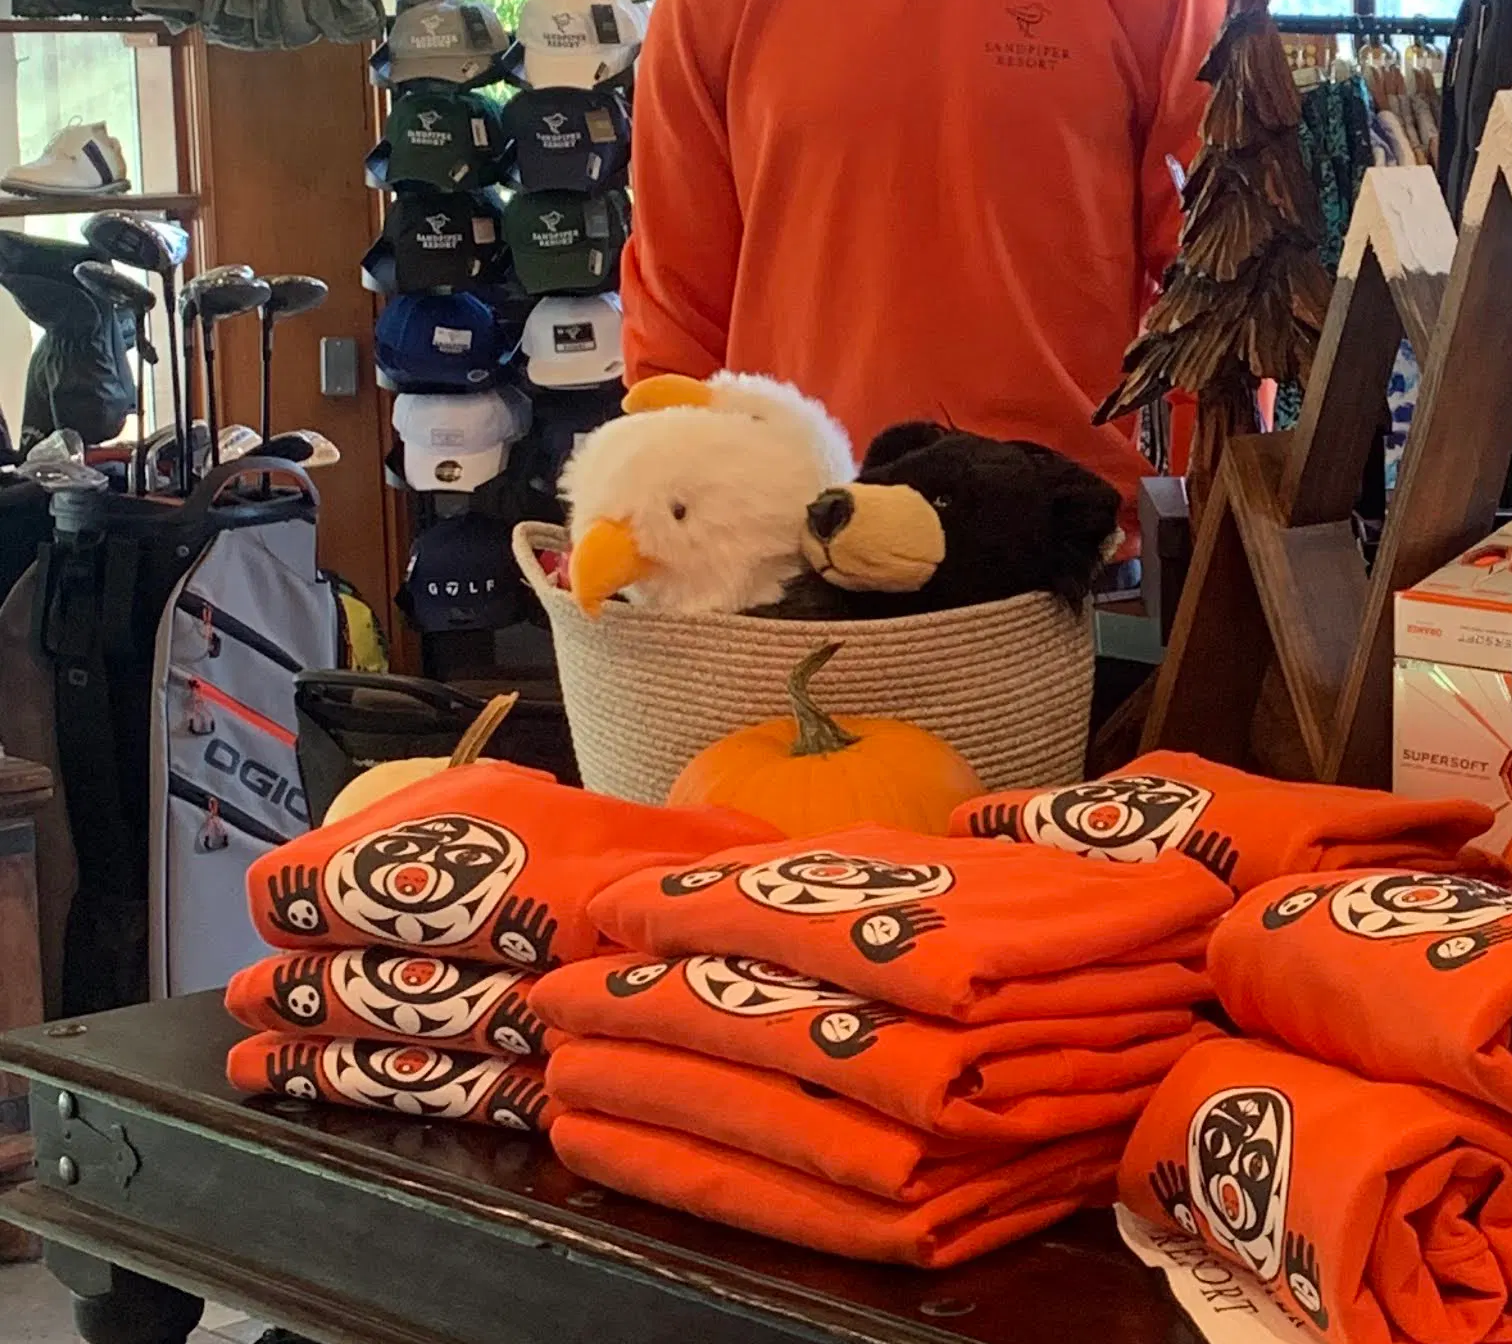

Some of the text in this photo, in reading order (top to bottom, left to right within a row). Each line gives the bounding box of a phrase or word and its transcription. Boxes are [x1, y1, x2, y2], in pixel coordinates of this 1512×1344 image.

[984, 41, 1071, 60] SANDPIPER
[1402, 748, 1489, 773] SUPERSOFT
[1150, 1232, 1259, 1315] REORT
